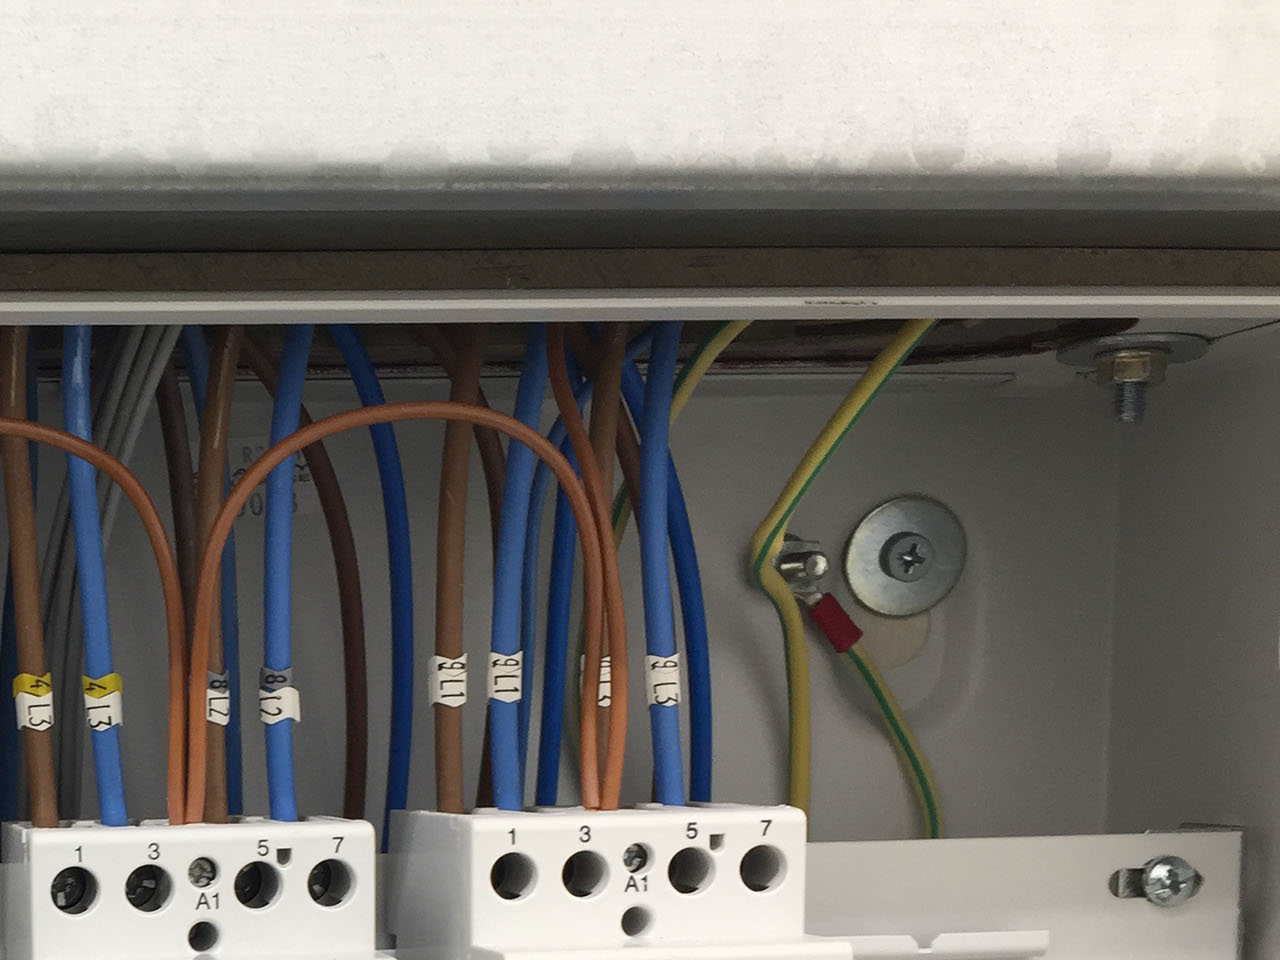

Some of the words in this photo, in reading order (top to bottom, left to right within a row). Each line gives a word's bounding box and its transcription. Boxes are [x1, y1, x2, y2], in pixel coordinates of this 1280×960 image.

[509, 828, 515, 845] 1
[580, 826, 591, 843] 3
[686, 822, 698, 839] 5
[761, 820, 772, 836] 7
[75, 846, 82, 862] 1
[148, 843, 160, 860] 3
[258, 840, 269, 856] 5
[332, 837, 344, 853] 7
[625, 875, 647, 892] A1
[196, 893, 219, 910] A1
